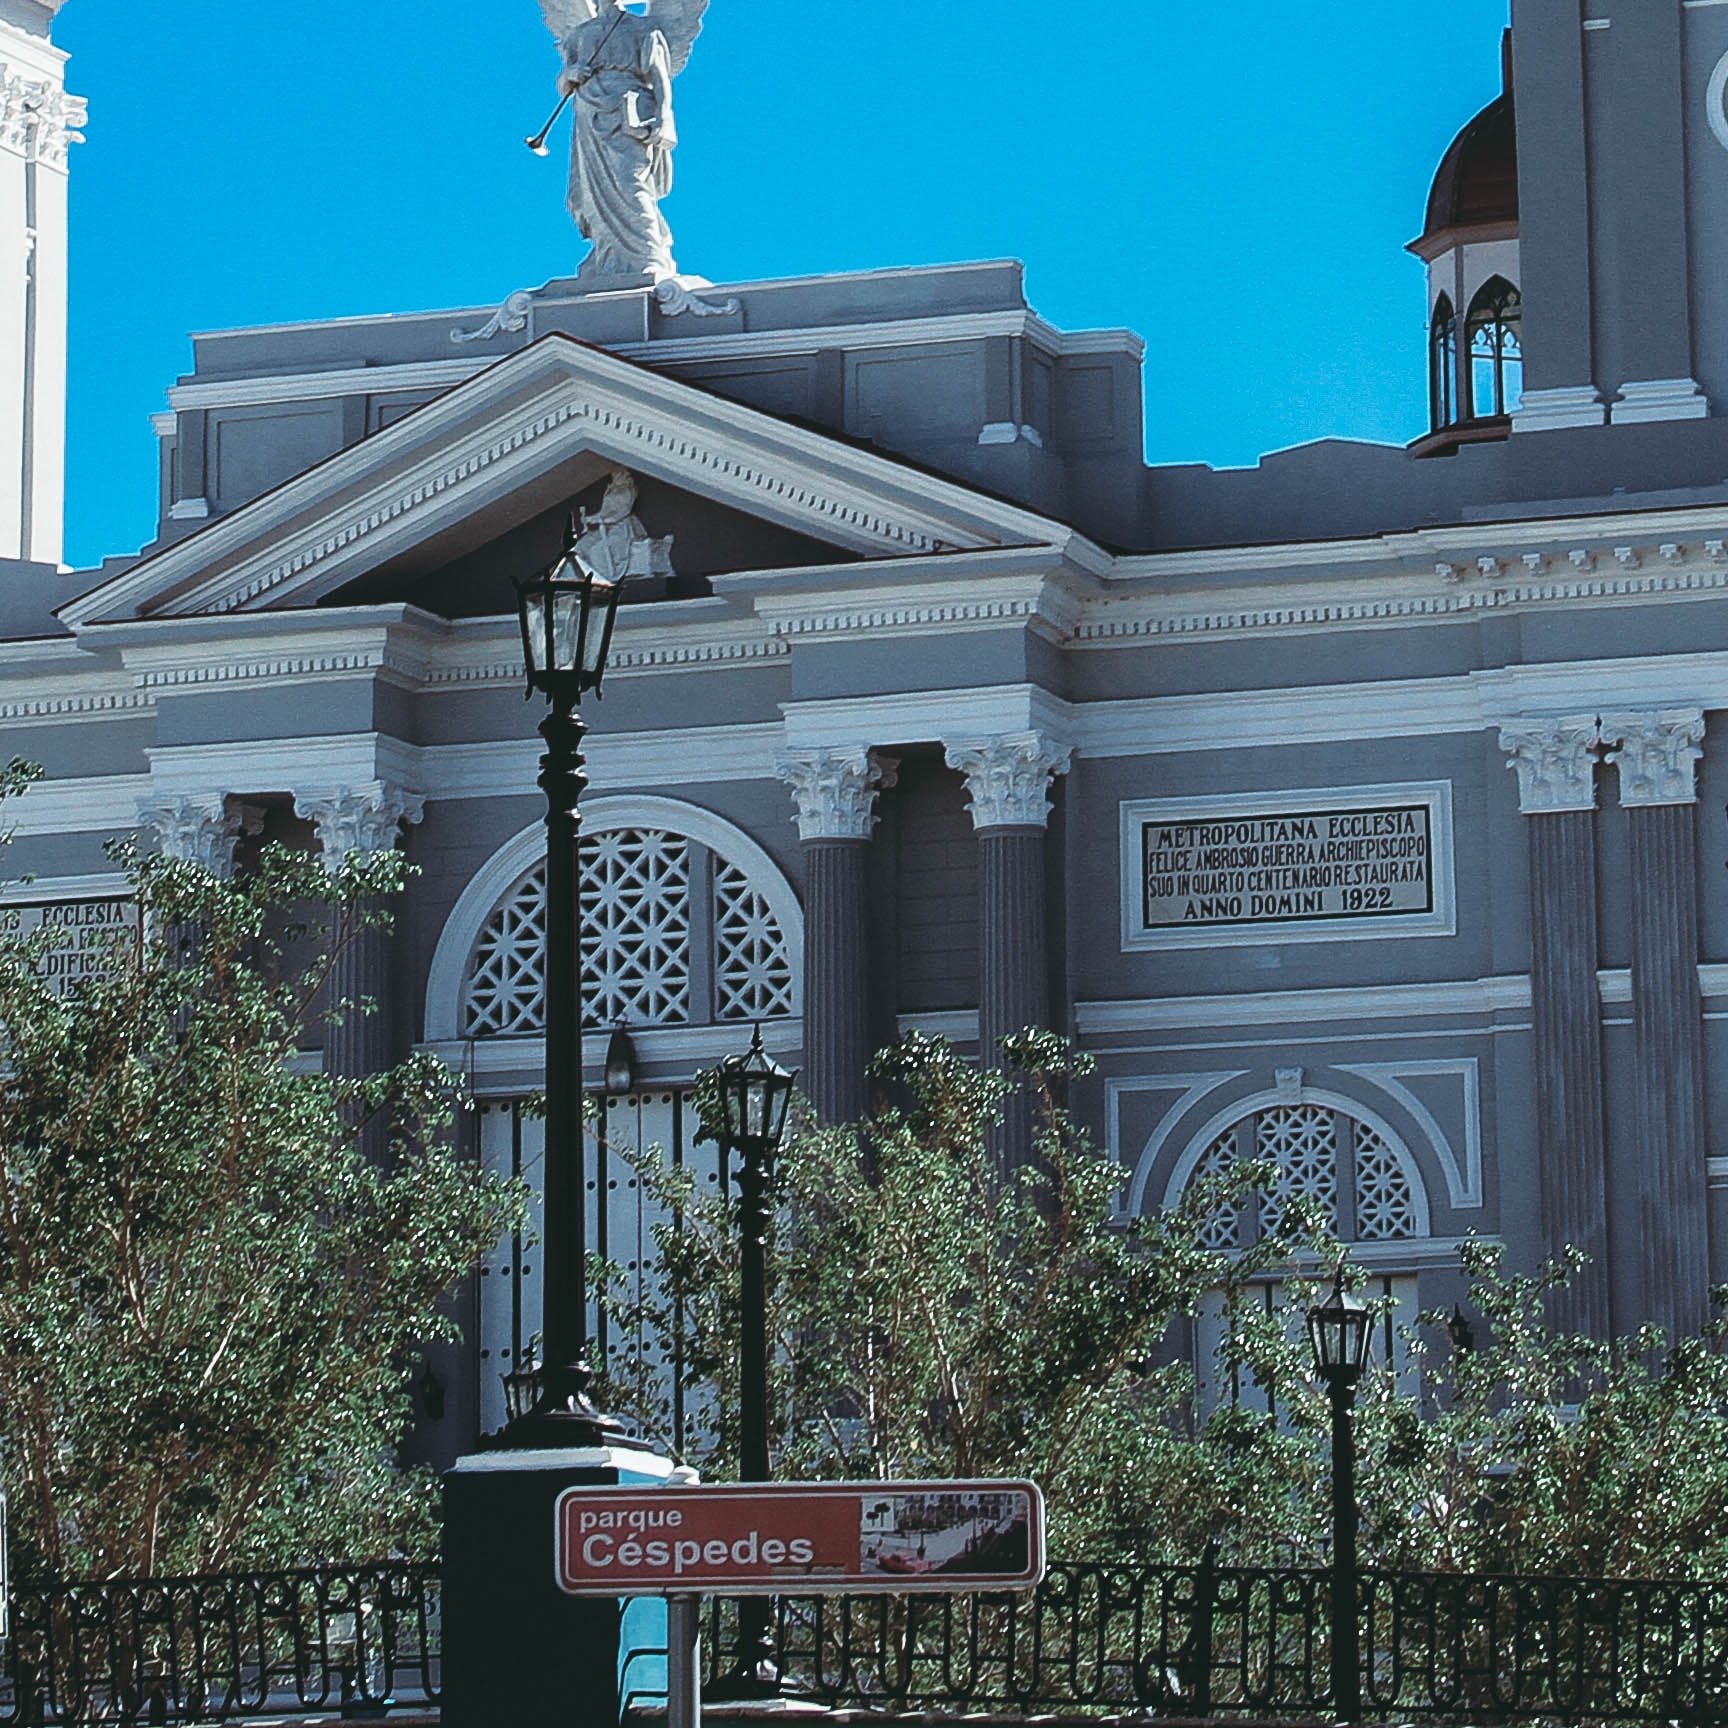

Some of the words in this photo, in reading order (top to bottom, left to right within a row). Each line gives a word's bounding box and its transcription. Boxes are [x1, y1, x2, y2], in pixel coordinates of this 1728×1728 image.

[1157, 819, 1318, 849] METROPOLITANA
[1328, 812, 1416, 838] ECCLESIA
[1149, 849, 1193, 874] FELICE
[1195, 845, 1259, 871] AMBROSIO
[1261, 842, 1315, 868] GUERRA
[1318, 834, 1425, 864] ARCHIEPISCOPO
[1148, 874, 1174, 897] SUO
[1176, 873, 1191, 896] IN
[1192, 871, 1244, 895] QUARTO
[1247, 864, 1332, 892] CENTENARIO
[1333, 859, 1425, 887] RESTAURATA
[1183, 896, 1243, 920] ANNO
[1250, 890, 1324, 917] DOMINI
[1341, 886, 1393, 911] 1922
[580, 1509, 683, 1534] parque
[582, 1530, 814, 1574] Céspedes
